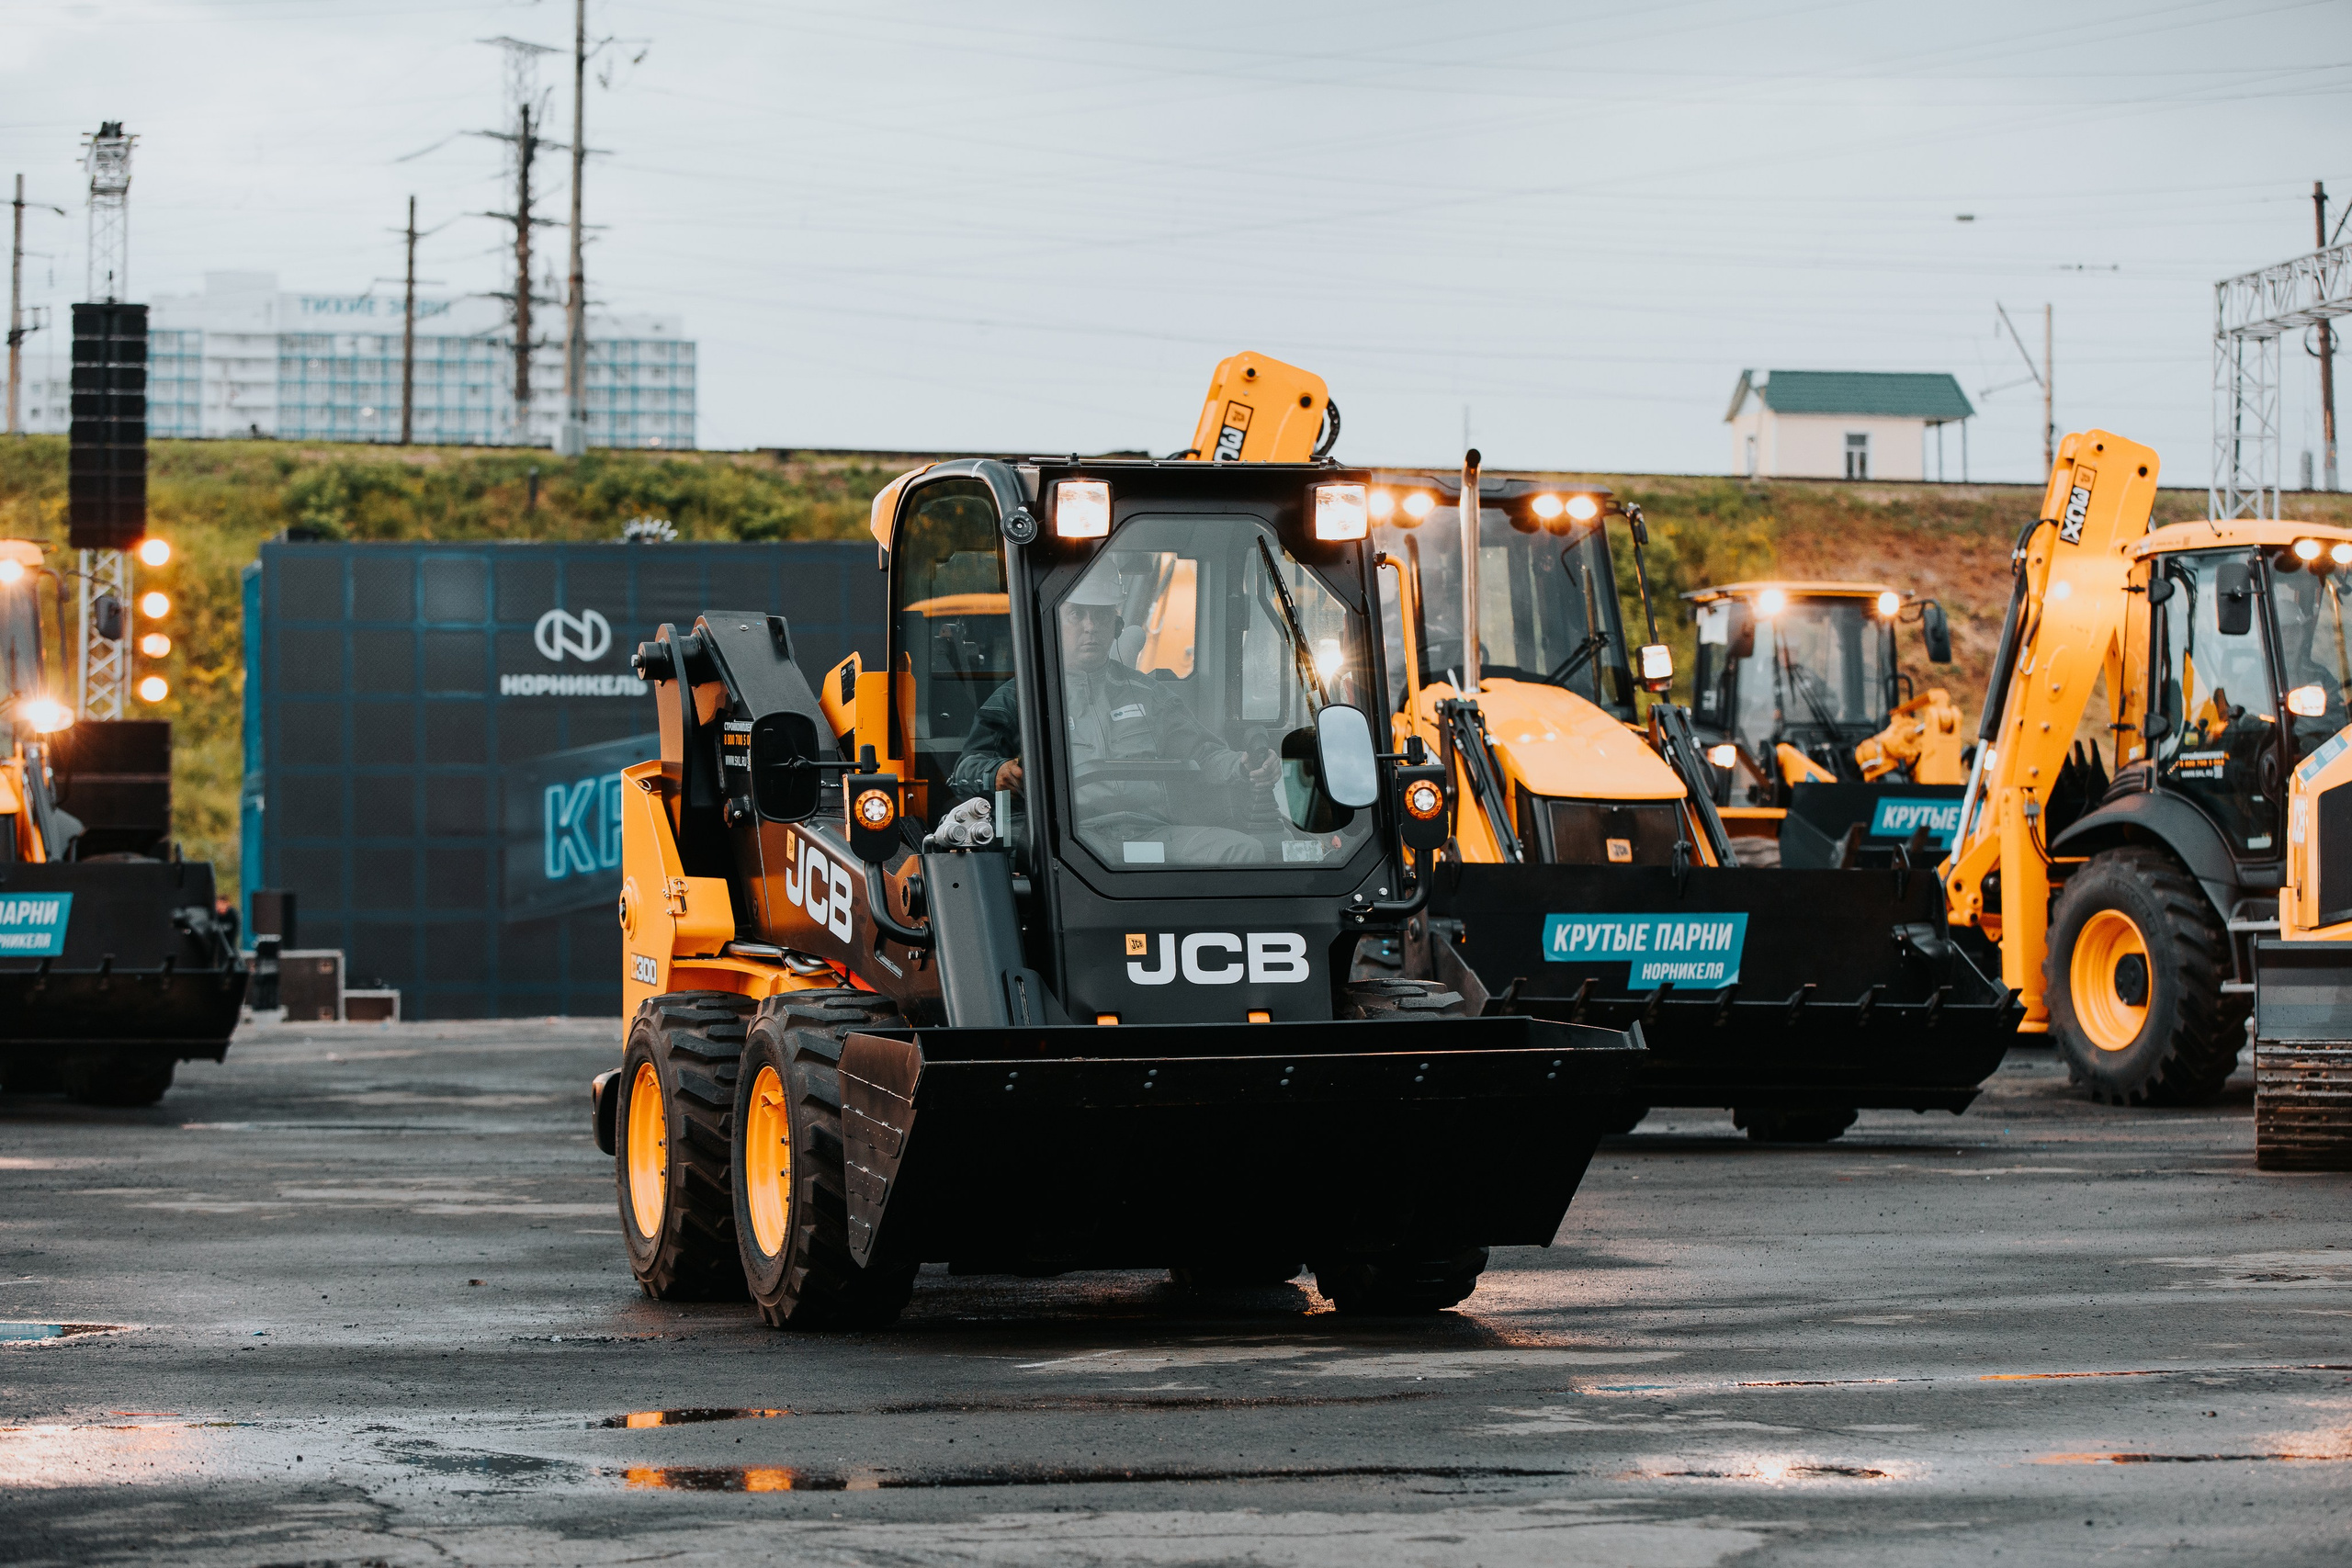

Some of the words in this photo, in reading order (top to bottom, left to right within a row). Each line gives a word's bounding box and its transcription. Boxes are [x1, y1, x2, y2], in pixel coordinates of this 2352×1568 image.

[1214, 426, 1244, 461] 3C
[2061, 486, 2090, 540] 3CX
[500, 673, 648, 696] НОРНИКЕЛЬ
[1882, 805, 1961, 830] КРУТЫЕ
[786, 837, 853, 943] JCB
[0, 932, 51, 949] НИКЕЛЯ
[1553, 923, 1650, 952] КРУТЫЕ
[1654, 922, 1734, 951] ПАРНИ
[637, 955, 657, 985] 300
[1126, 932, 1310, 985] JCB
[1641, 962, 1724, 980] НОРНИКЕЛЯ
